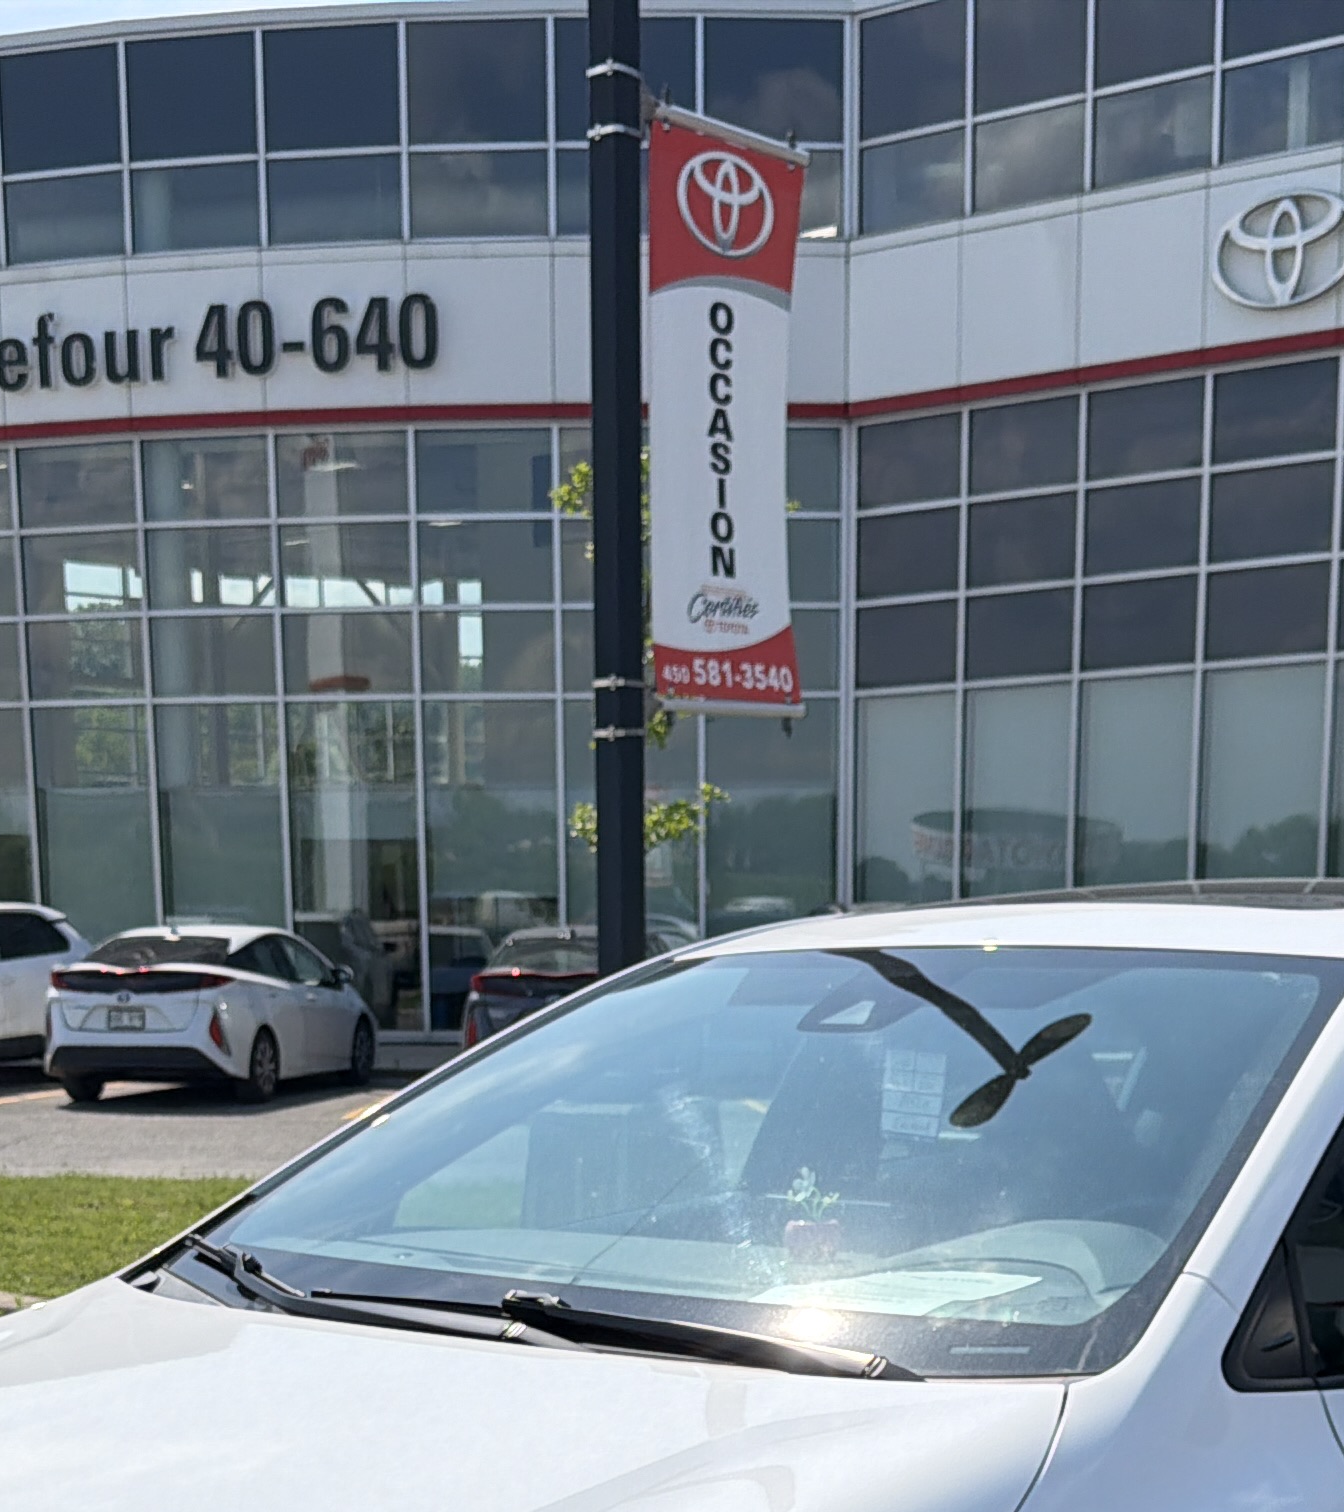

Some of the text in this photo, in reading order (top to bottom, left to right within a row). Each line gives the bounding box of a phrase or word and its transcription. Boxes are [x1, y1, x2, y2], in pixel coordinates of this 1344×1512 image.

[194, 293, 440, 379] 40-640
[708, 301, 736, 579] OCCASION
[661, 656, 794, 693] 450 581-3540
